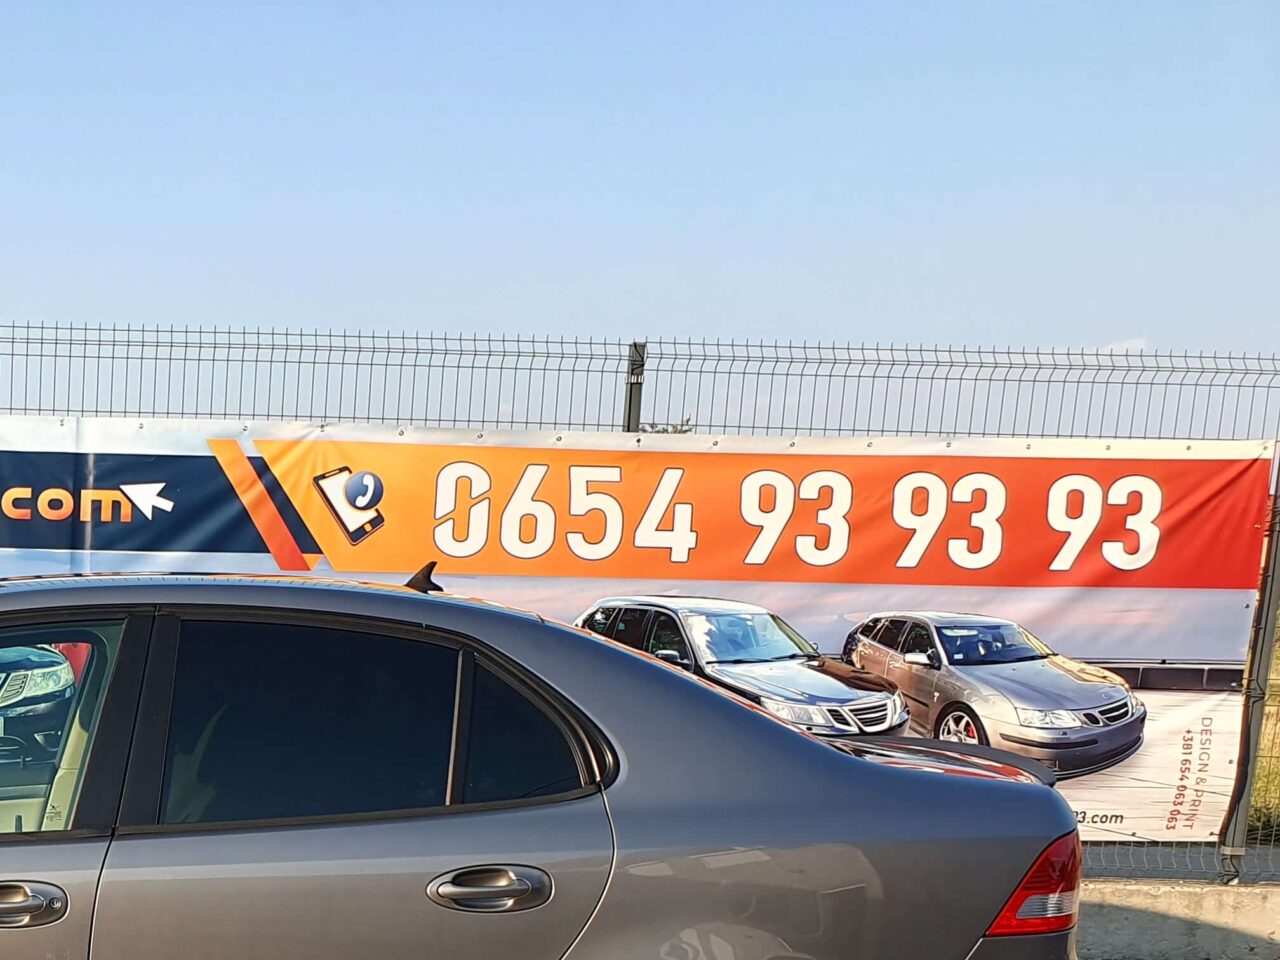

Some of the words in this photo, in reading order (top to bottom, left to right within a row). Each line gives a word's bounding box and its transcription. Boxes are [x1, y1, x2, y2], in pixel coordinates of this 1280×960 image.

[433, 460, 698, 563] 0654
[739, 469, 853, 567] 93
[891, 471, 1007, 569] 93
[1046, 473, 1163, 572] 93
[1182, 729, 1194, 757] +381
[1198, 717, 1213, 773] DESIGN
[1179, 760, 1192, 781] 654
[1173, 785, 1188, 807] 063
[1183, 788, 1203, 830] PRINT
[1166, 809, 1181, 830] 063
